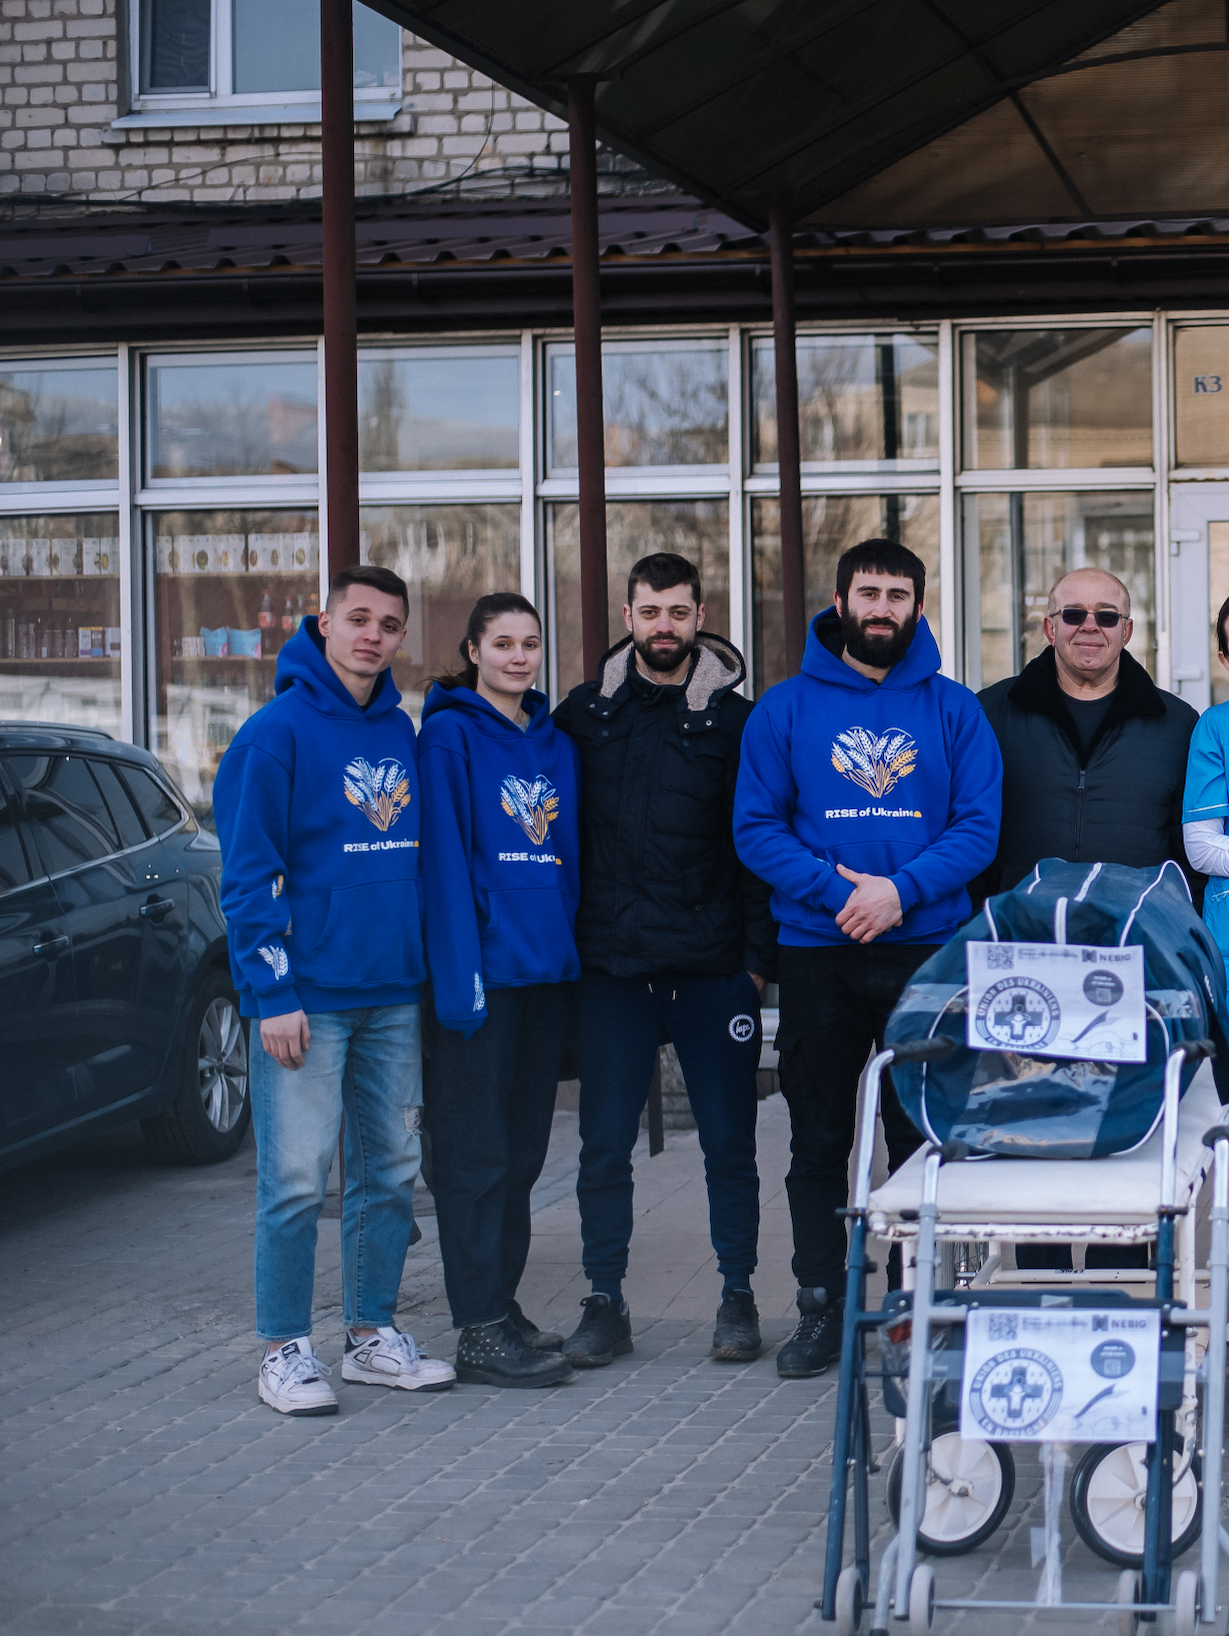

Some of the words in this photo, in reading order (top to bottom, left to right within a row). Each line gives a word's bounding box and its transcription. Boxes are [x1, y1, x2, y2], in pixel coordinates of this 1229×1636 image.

[1194, 374, 1223, 393] КЗ
[825, 808, 858, 819] RISE
[344, 842, 369, 853] RISE
[499, 852, 528, 862] RISE
[1099, 953, 1132, 962] NEBIG
[978, 987, 997, 1016] UNION
[998, 978, 1015, 989] DES
[1017, 977, 1060, 1016] UKRAINIENS
[1111, 1319, 1147, 1328] NEBIG
[972, 1359, 997, 1390] UNION
[997, 1351, 1017, 1363] DES
